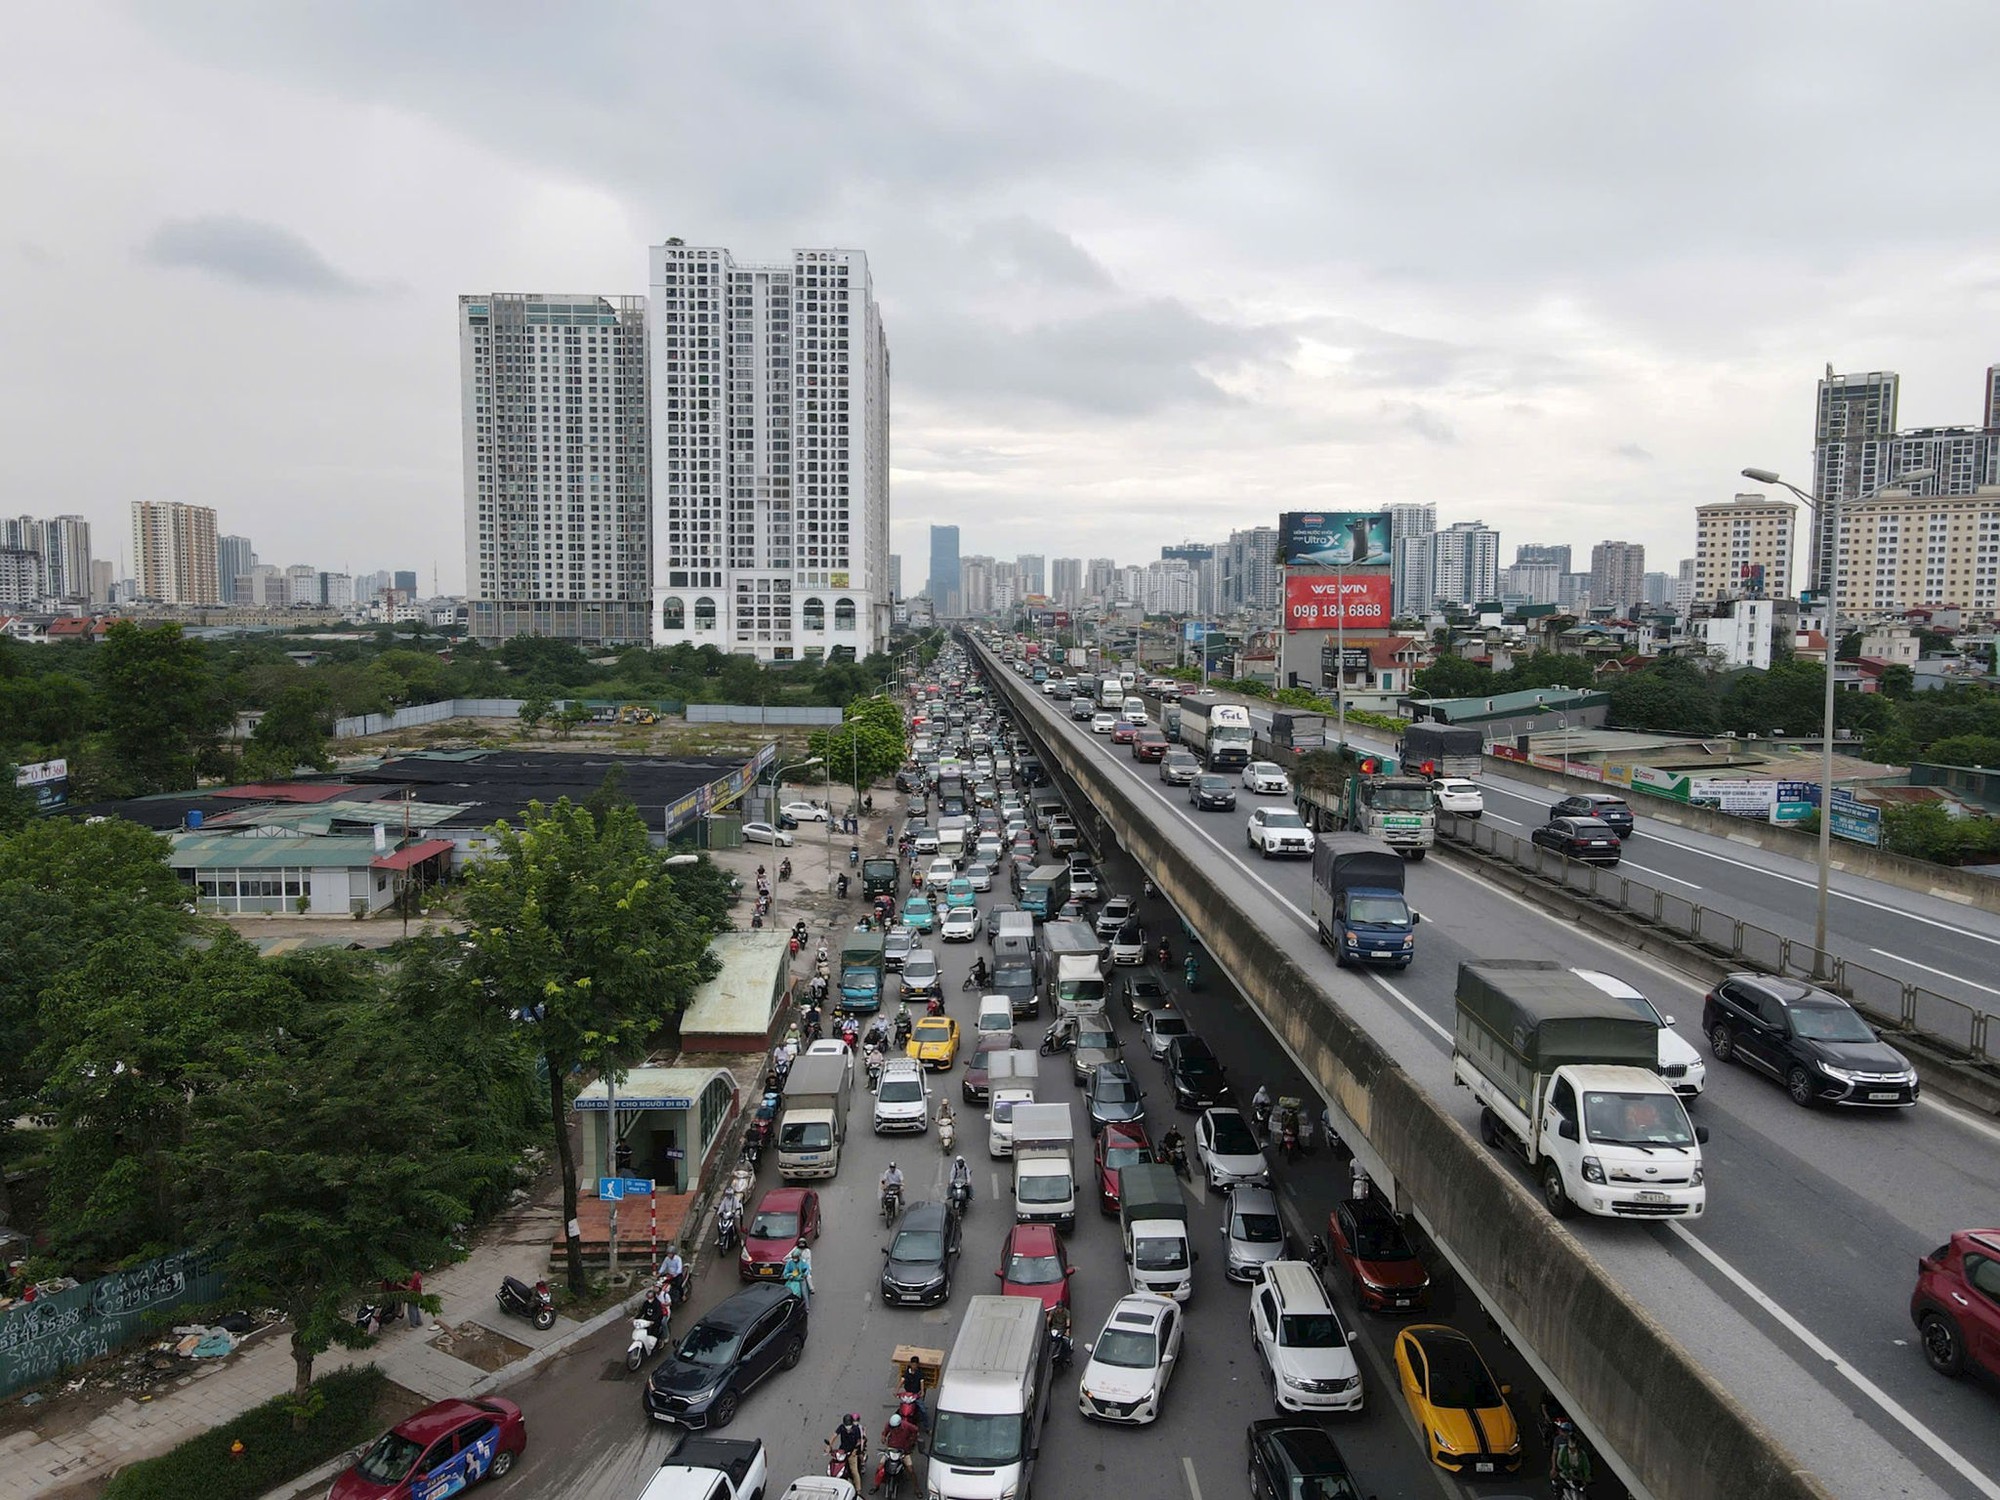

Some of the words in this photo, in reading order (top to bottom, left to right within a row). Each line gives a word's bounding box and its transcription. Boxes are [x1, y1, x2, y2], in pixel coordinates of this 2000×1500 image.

[1311, 584, 1335, 594] WE
[1338, 584, 1367, 594] WIN
[1293, 605, 1318, 617] 096
[1348, 604, 1381, 617] 6868
